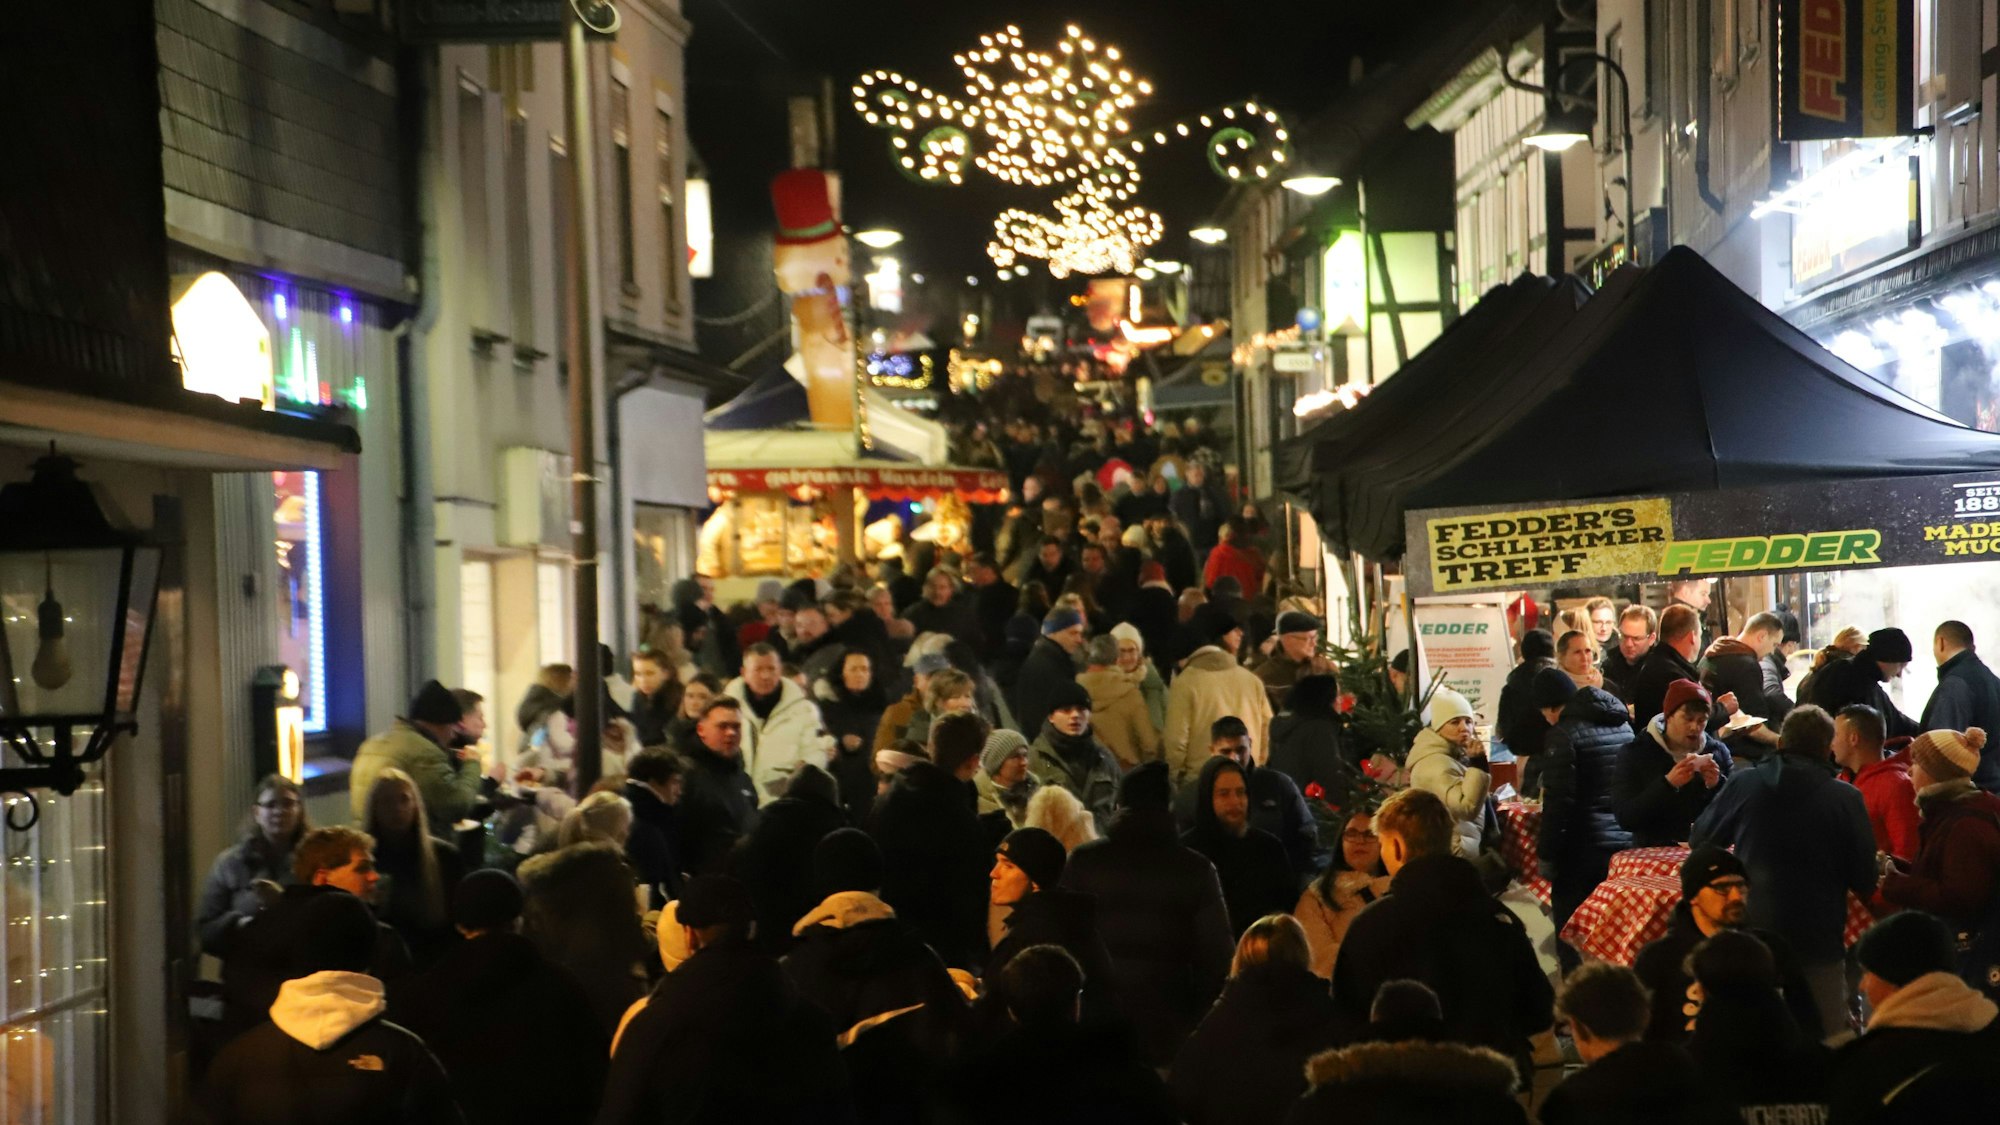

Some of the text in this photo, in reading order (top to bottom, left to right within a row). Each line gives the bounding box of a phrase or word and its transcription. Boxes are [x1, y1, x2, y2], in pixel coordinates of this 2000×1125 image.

[765, 469, 871, 489] gebrannte
[1954, 496, 2000, 512] 188
[1965, 487, 2000, 498] SEIT
[1434, 508, 1636, 543] FEDDER'S
[1923, 521, 2000, 541] MADE
[1436, 526, 1665, 561] SCHLEMMER
[1660, 531, 1879, 573] FEDDER
[1438, 553, 1587, 584] TREFF
